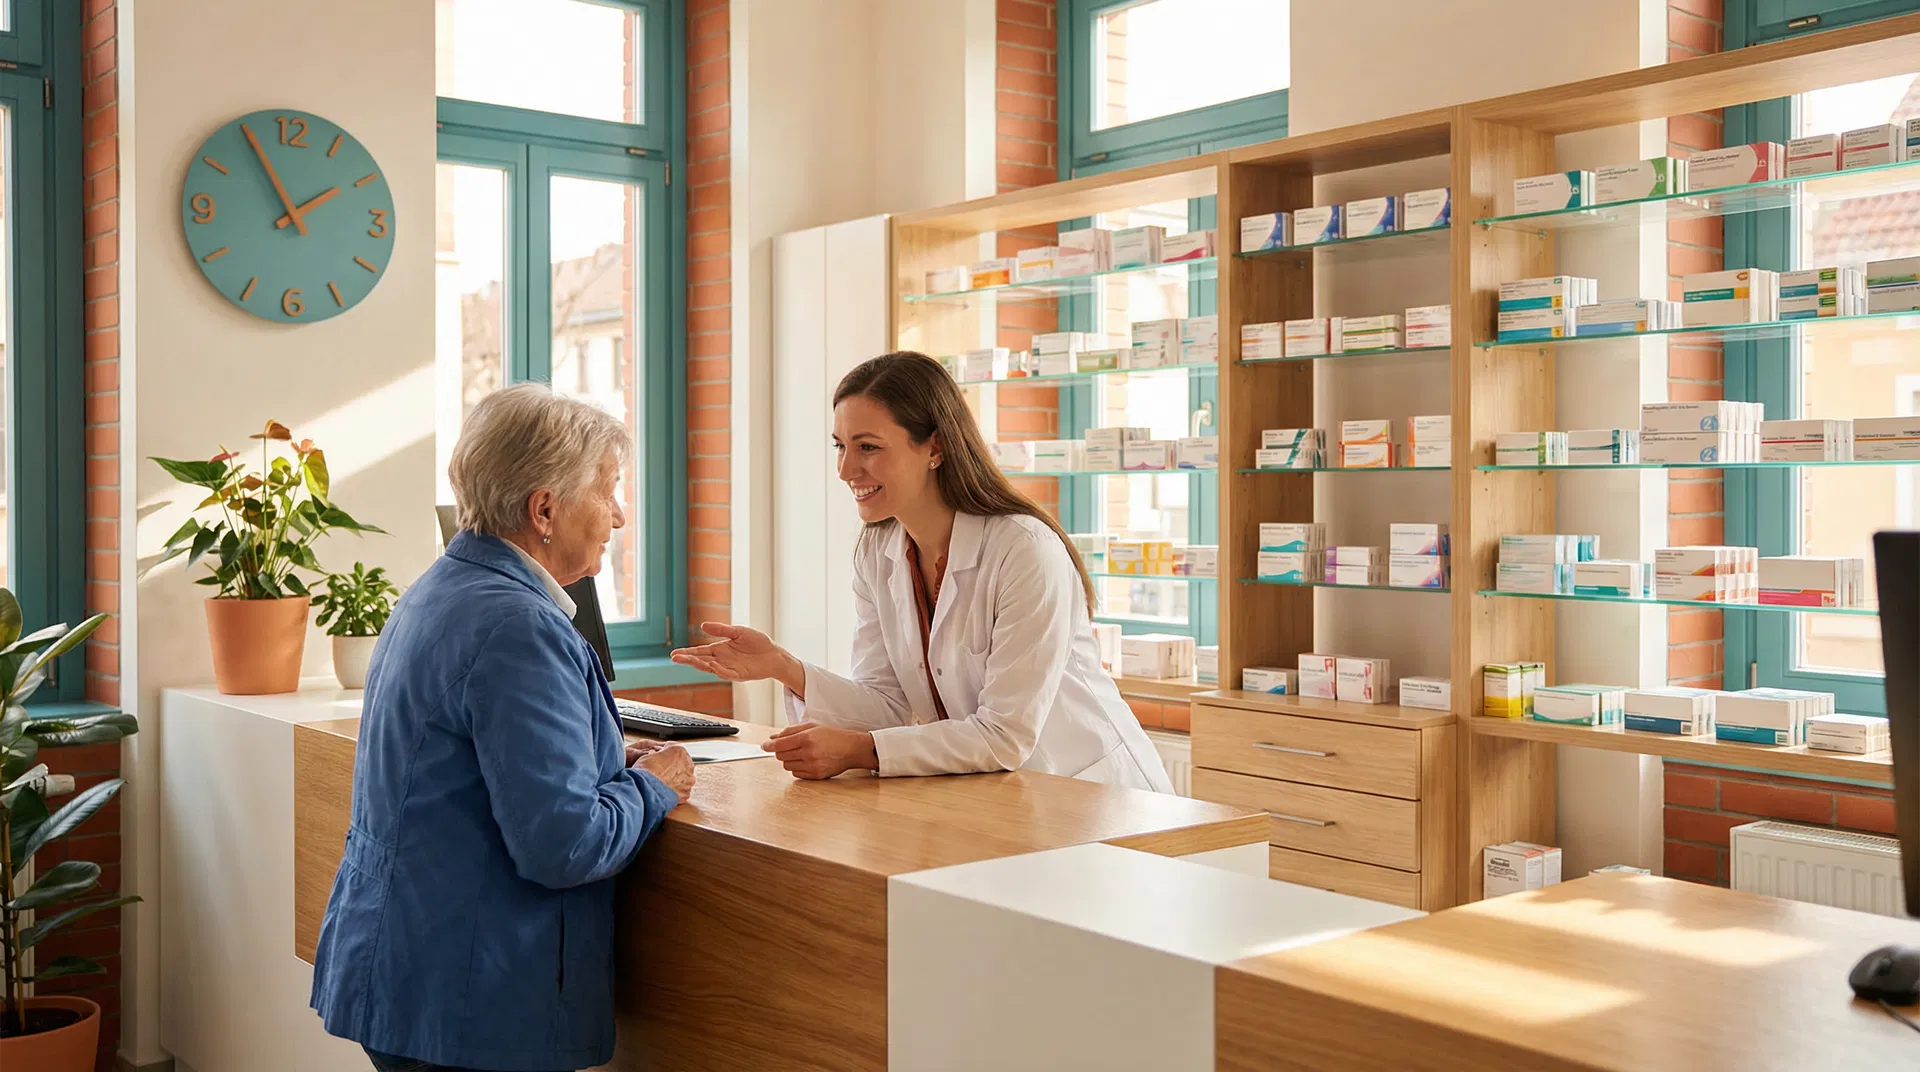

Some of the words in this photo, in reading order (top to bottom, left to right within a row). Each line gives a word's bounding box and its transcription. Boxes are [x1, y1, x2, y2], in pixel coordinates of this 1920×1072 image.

[275, 115, 310, 148] 12
[191, 193, 215, 224] 9
[368, 208, 388, 238] 3
[281, 287, 305, 317] 6
